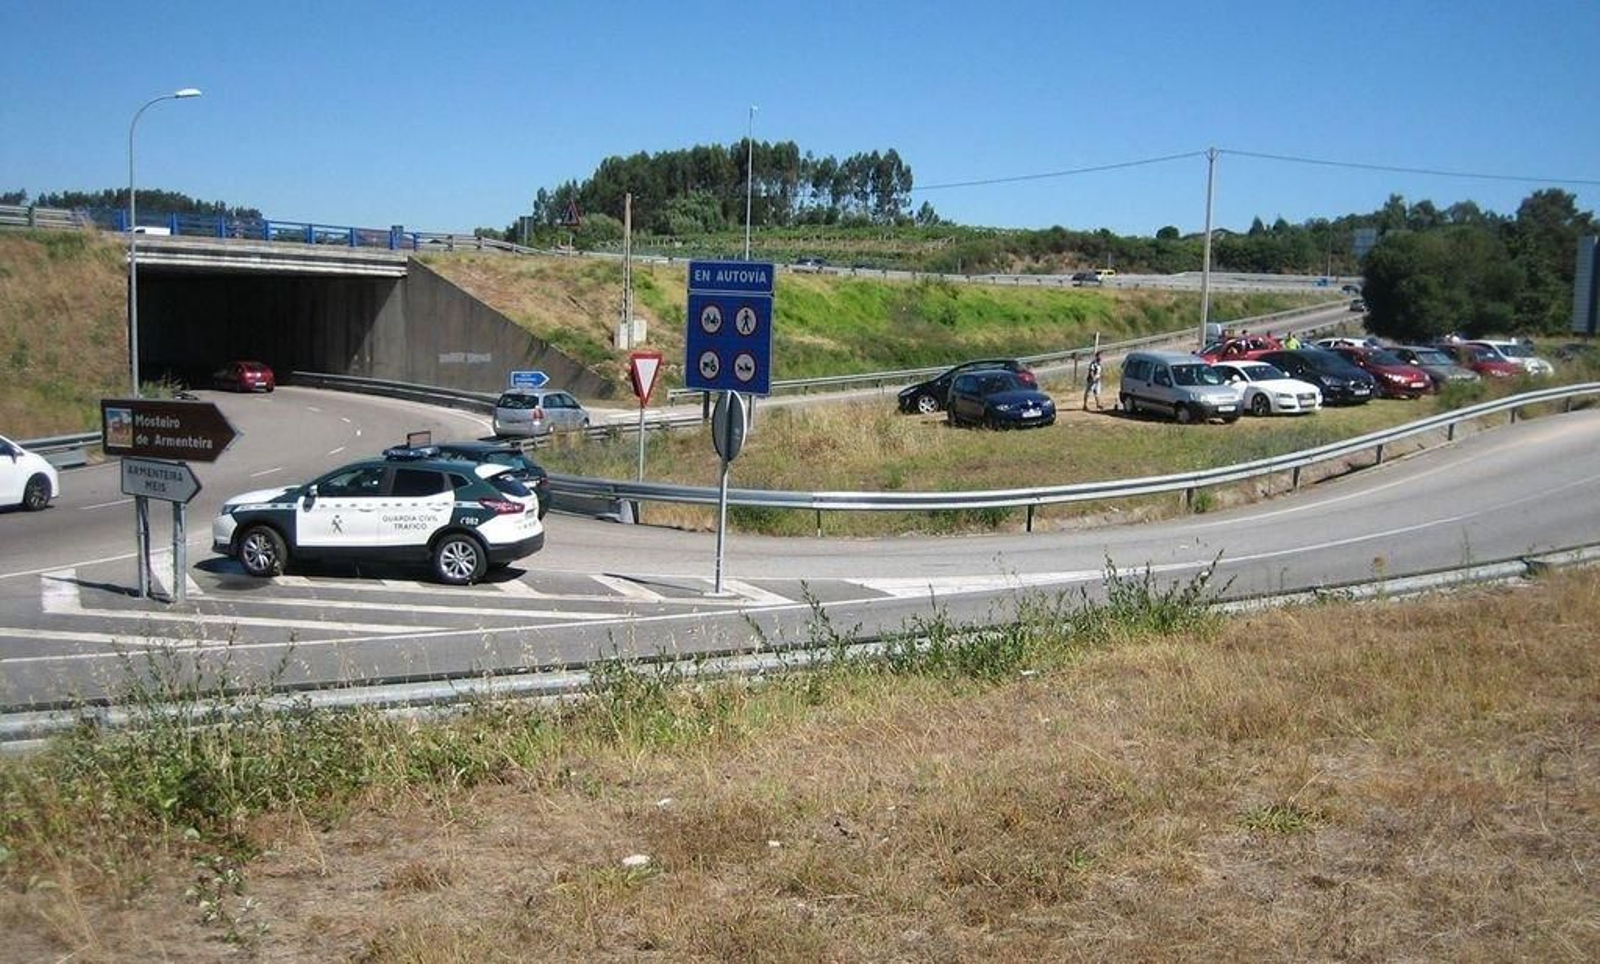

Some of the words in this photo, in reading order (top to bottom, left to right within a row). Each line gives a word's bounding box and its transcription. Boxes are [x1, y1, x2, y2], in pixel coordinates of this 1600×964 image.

[694, 269, 710, 282] EN
[135, 415, 180, 428] Mosteiro
[136, 434, 149, 446] de
[155, 434, 213, 449] Armenteira
[128, 465, 183, 482] ARMENTEIRA
[145, 481, 166, 492] MEIS
